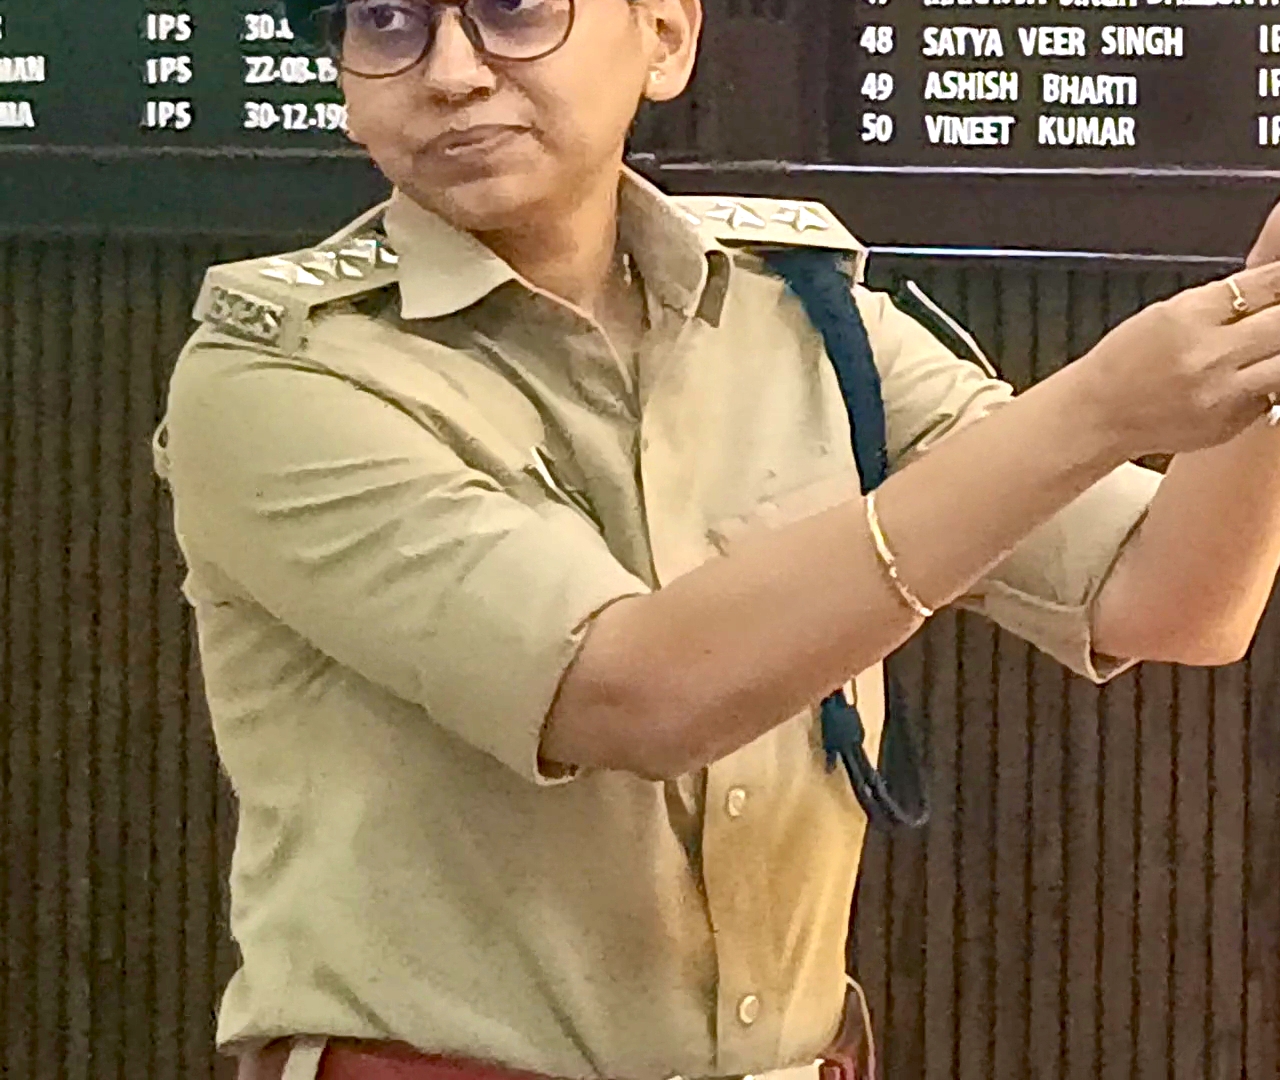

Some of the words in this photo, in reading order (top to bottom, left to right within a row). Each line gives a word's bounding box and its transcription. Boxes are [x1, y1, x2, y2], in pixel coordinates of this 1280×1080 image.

[860, 26, 893, 53] 48
[923, 27, 1003, 57] SATYA
[1018, 27, 1085, 56] VEER
[1102, 26, 1183, 56] SINGH
[861, 73, 893, 100] 49
[925, 71, 1018, 100] ASHISH
[1043, 73, 1136, 104] BHARTI
[142, 102, 191, 129] IPS
[862, 113, 892, 141] 50
[925, 115, 1014, 144] VINEET
[1039, 115, 1135, 146] KUMAR
